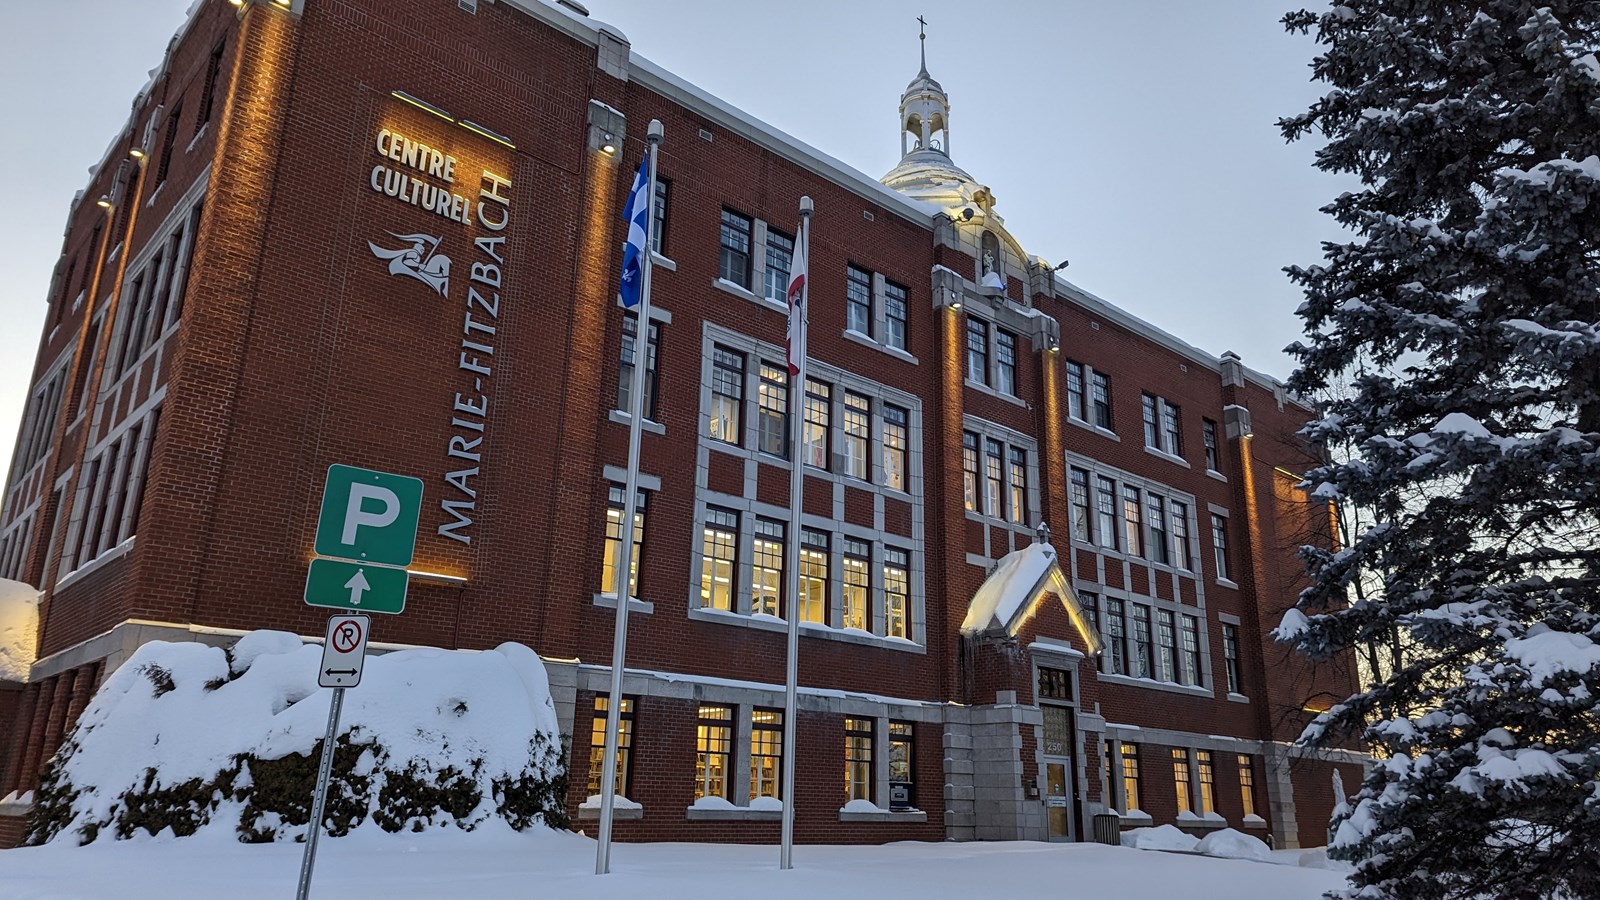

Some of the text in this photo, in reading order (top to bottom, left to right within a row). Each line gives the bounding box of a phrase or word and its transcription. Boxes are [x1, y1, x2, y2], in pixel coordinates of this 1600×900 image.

[376, 128, 457, 183] CENTRE
[370, 165, 472, 226] CULTUREL
[437, 169, 513, 545] MARIE-FITZBACH
[340, 481, 401, 546] P
[1047, 742, 1062, 752] 250
